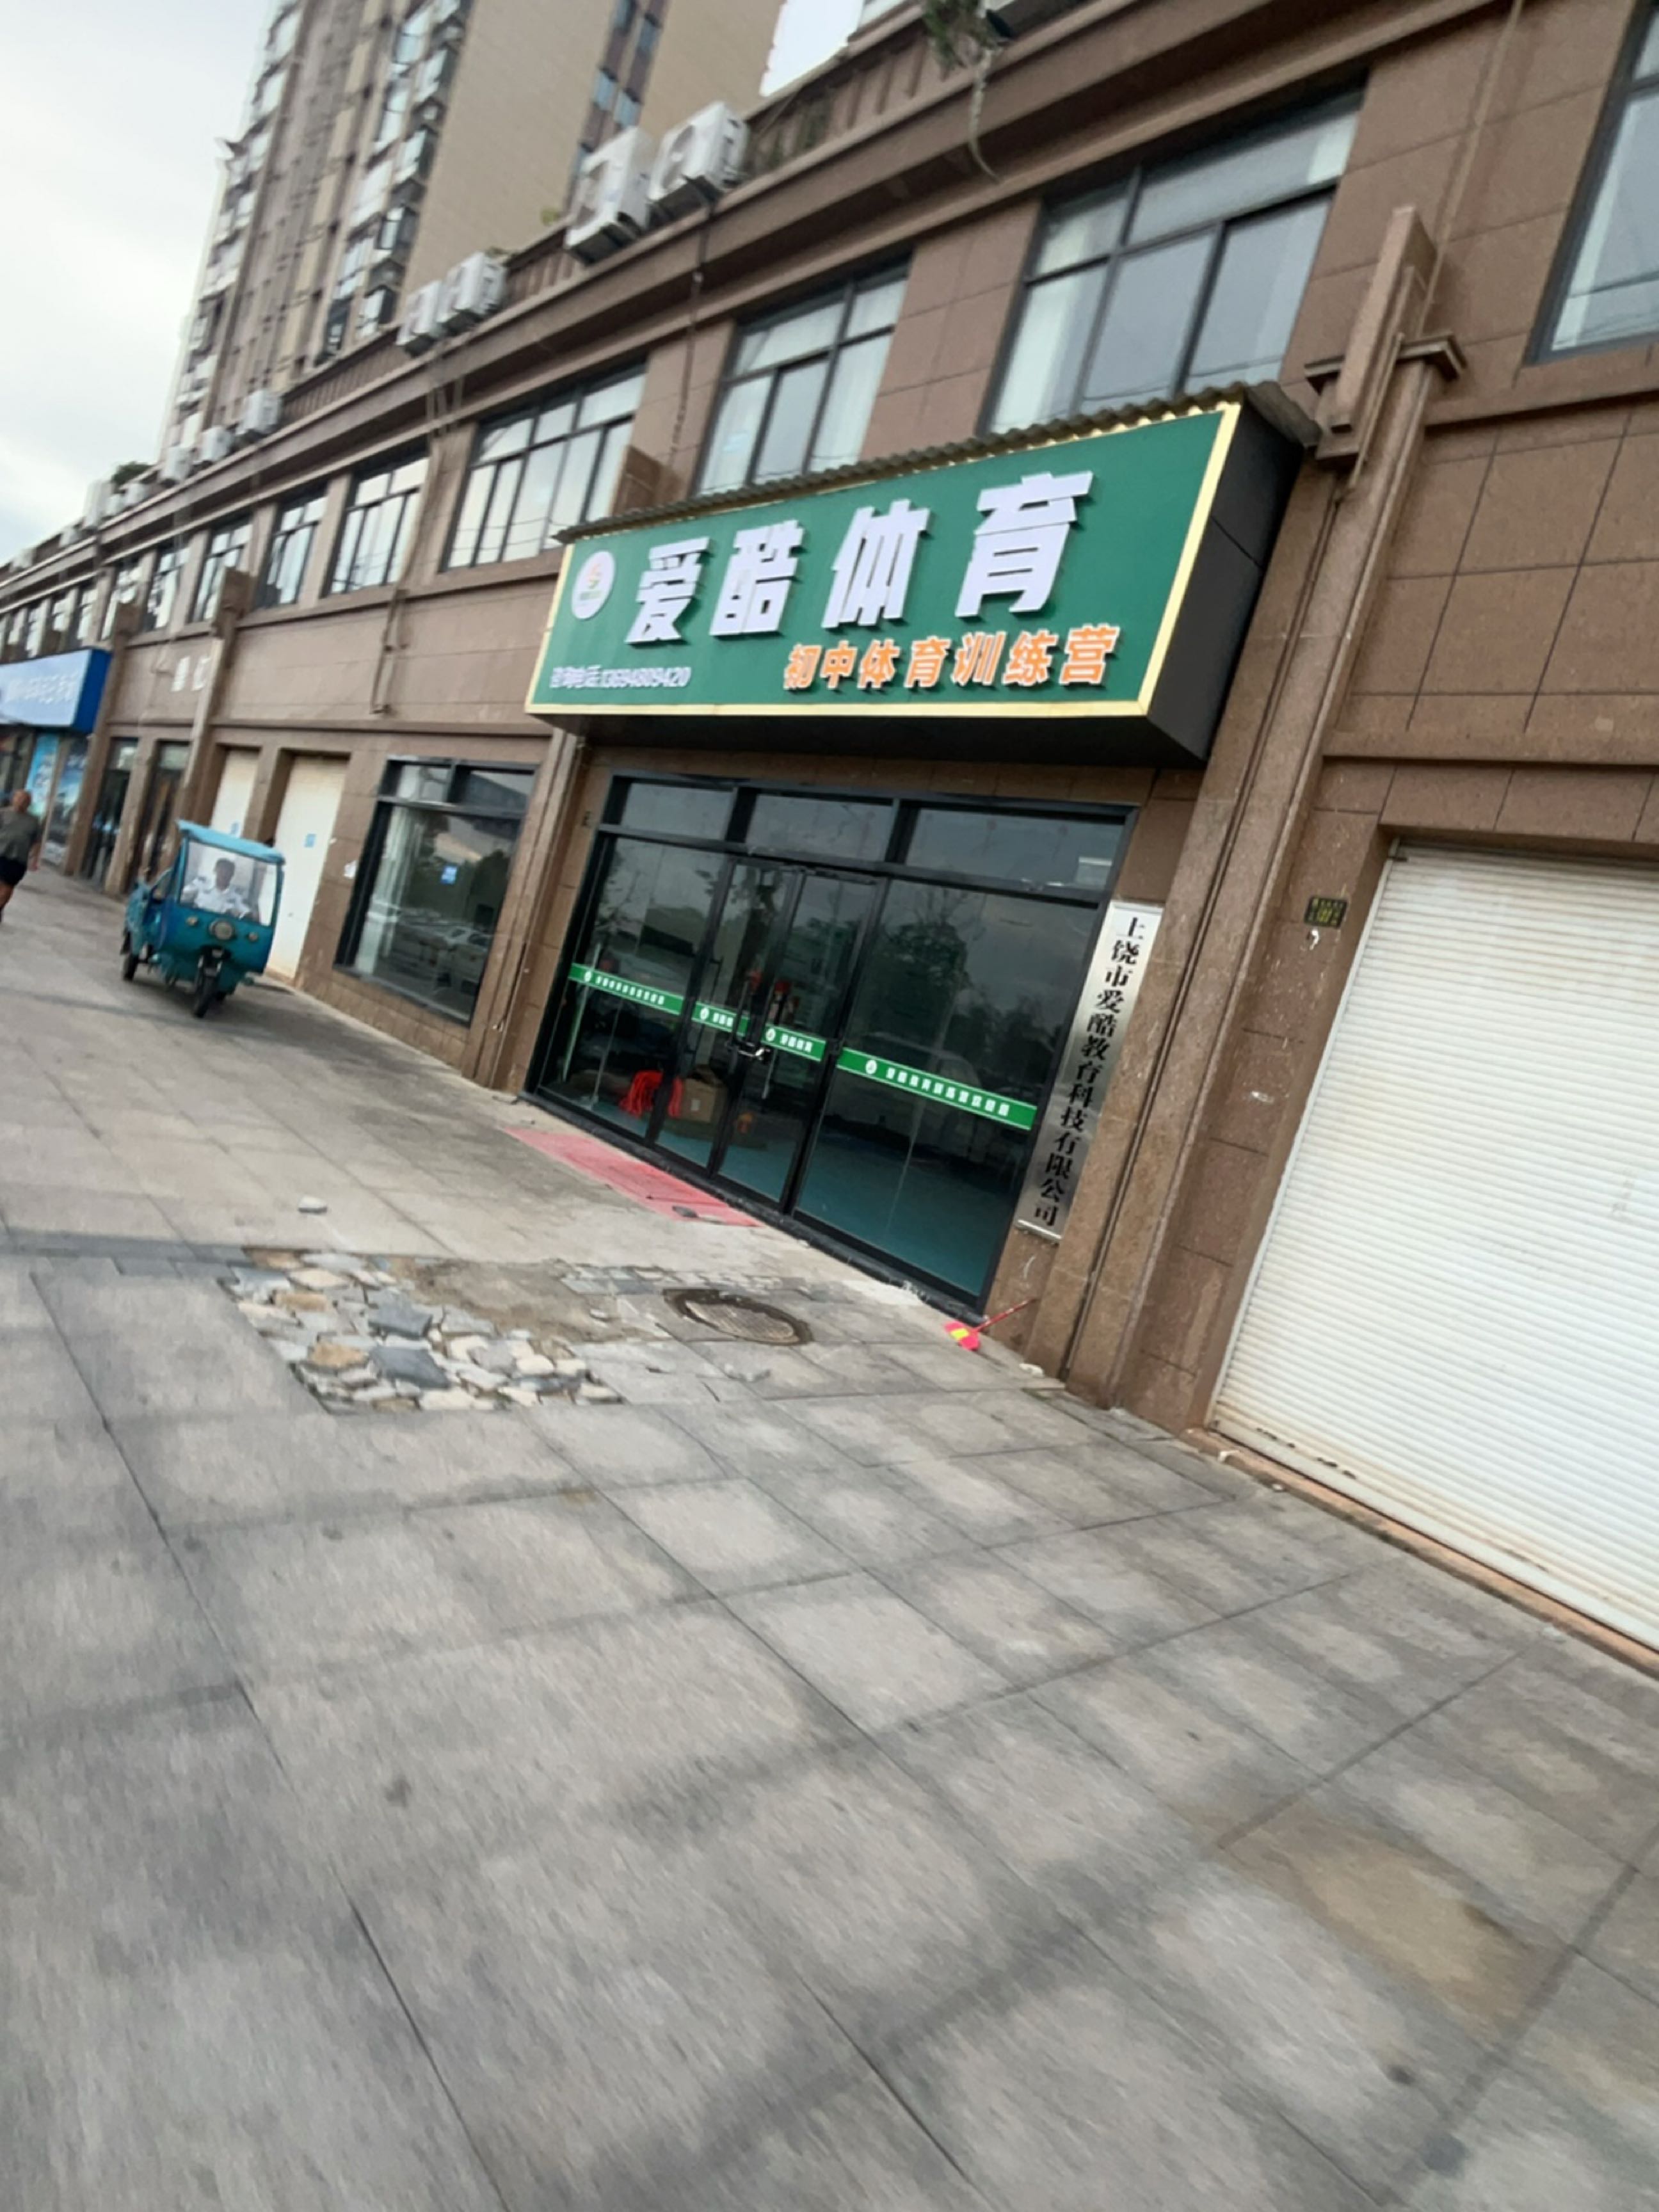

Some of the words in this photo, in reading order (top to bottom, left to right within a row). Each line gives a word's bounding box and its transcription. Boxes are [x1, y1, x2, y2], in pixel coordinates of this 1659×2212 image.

[626, 470, 1094, 644] 爱酷体育
[783, 623, 1120, 690] 初中体育训练营
[1034, 917, 1147, 1226] 上饶市爱酷教育科技有限公司
